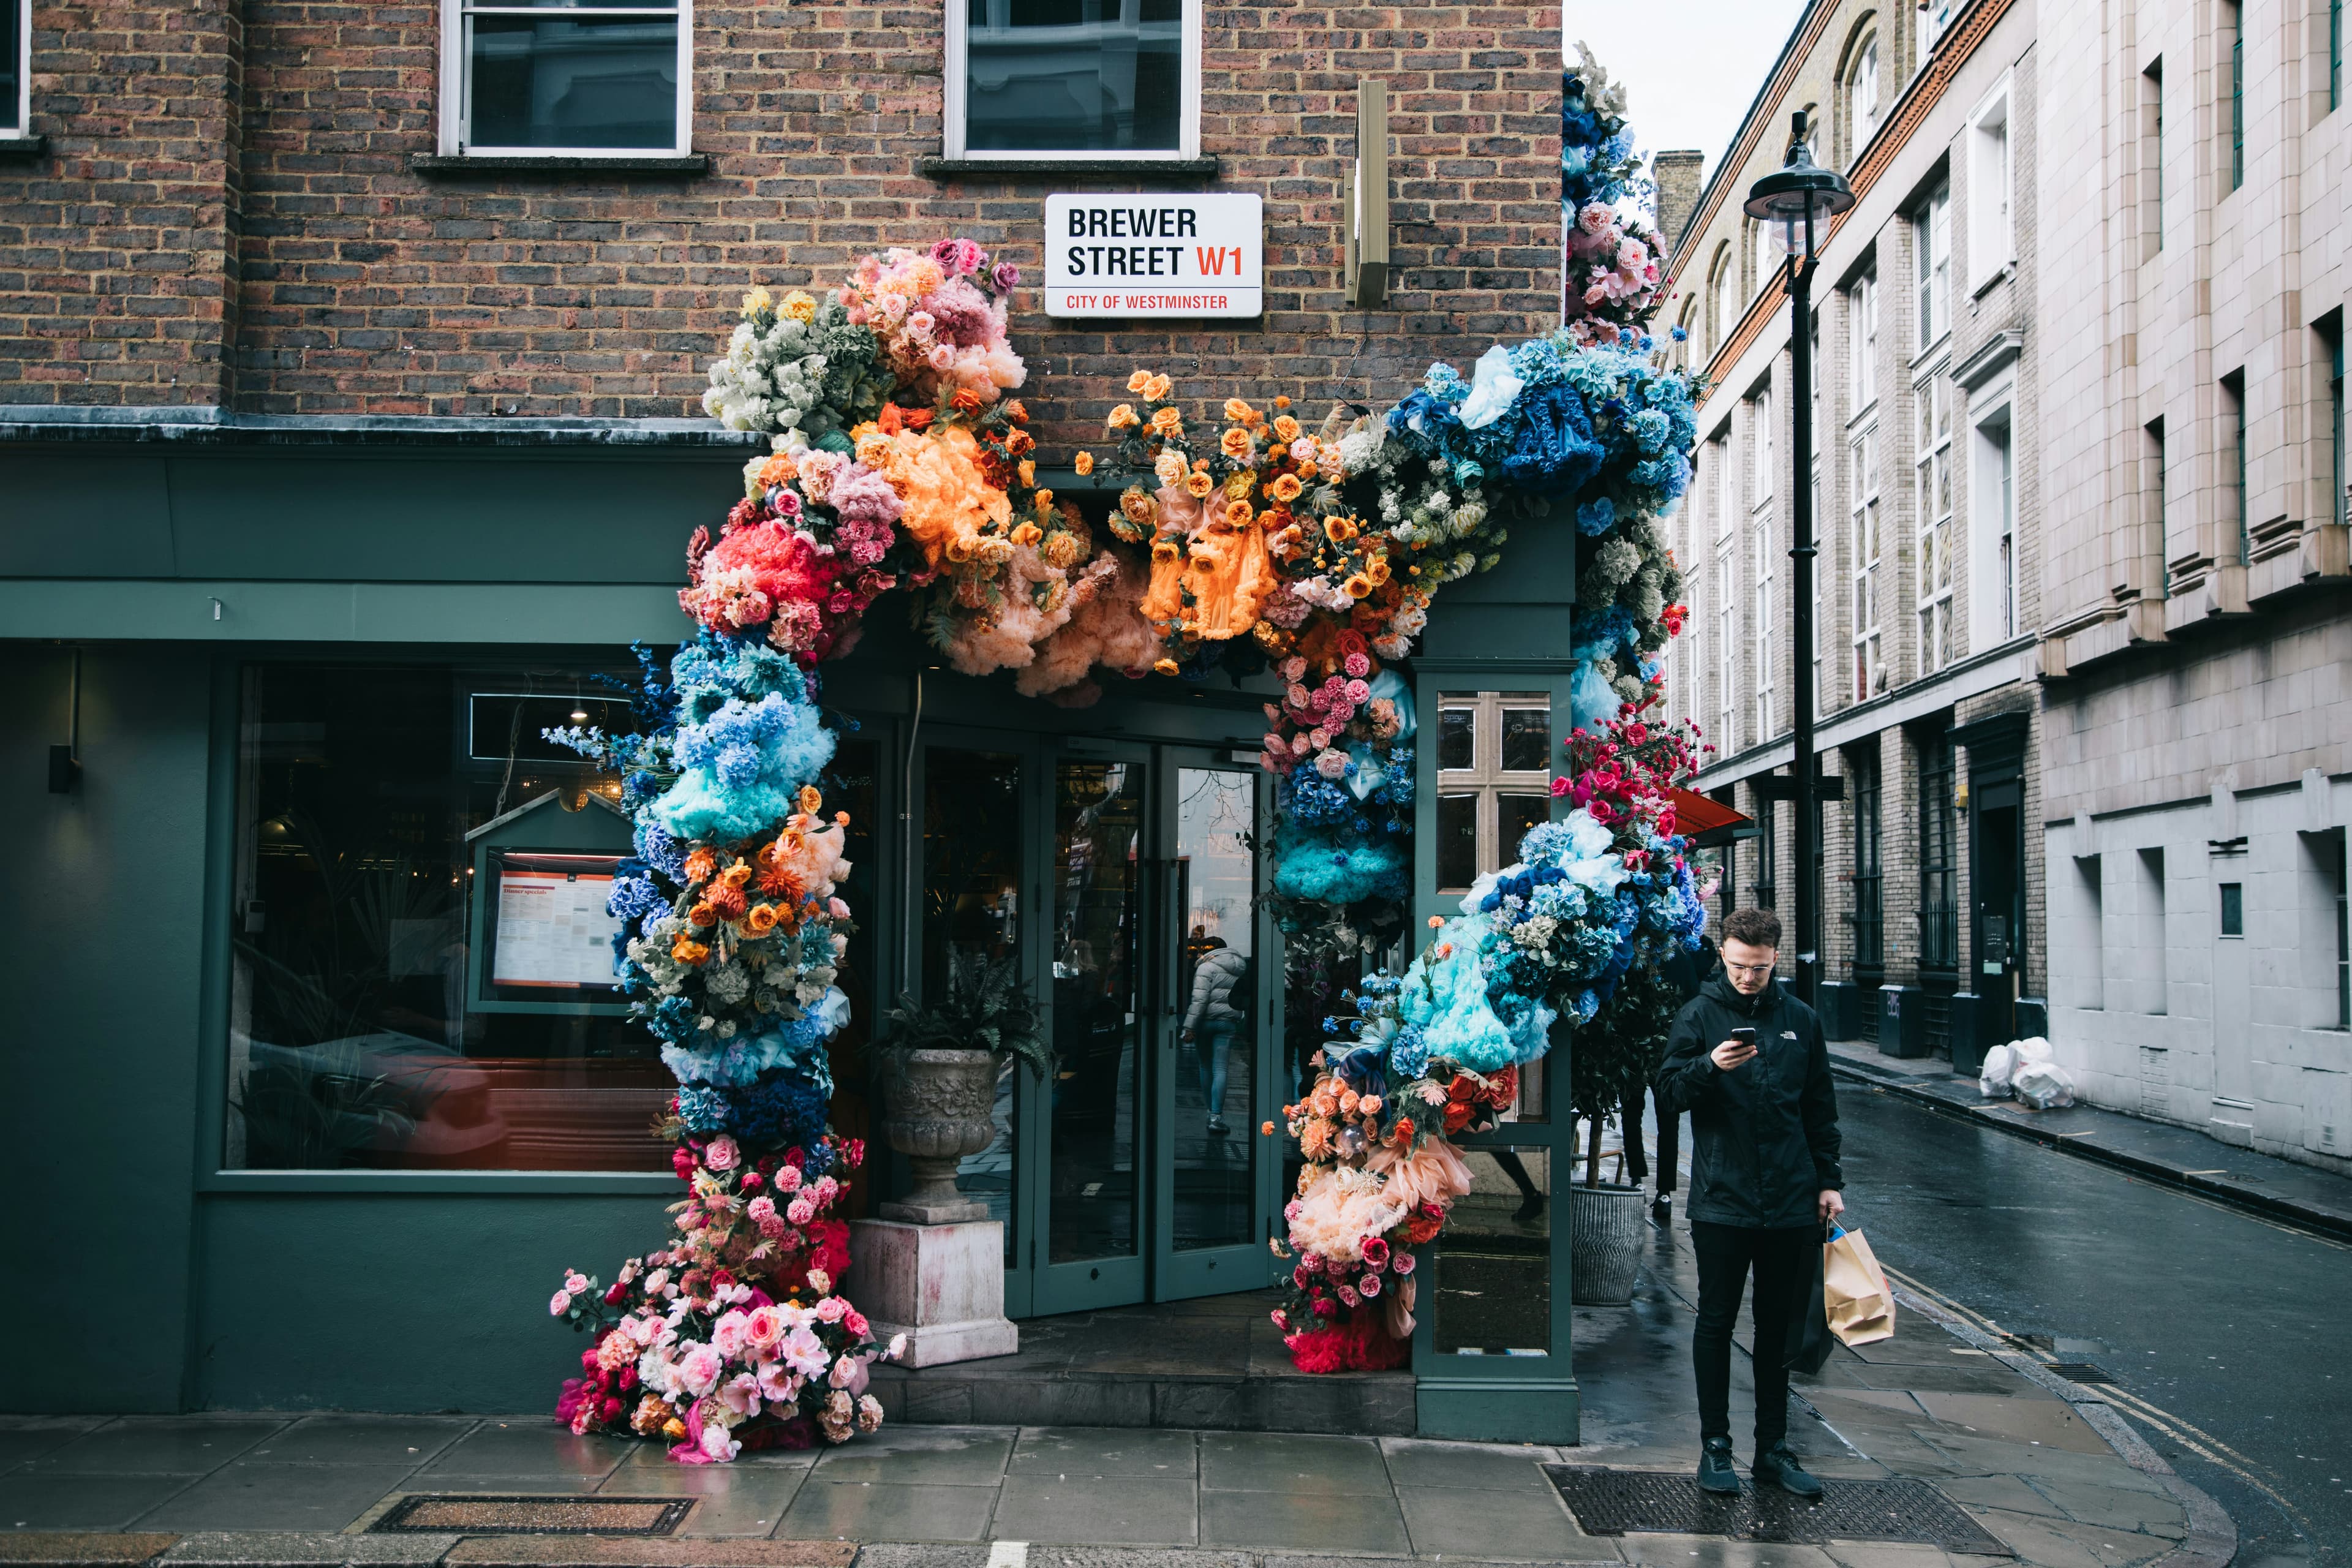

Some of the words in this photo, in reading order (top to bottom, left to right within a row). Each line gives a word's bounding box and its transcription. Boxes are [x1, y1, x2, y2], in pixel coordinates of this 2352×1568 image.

[1069, 208, 1197, 238] BREWER
[1068, 246, 1184, 276] STREET
[1196, 246, 1242, 276] W1
[1066, 295, 1098, 309] CITY
[1103, 295, 1120, 309] OF
[1126, 295, 1227, 309] WESTMINSTER
